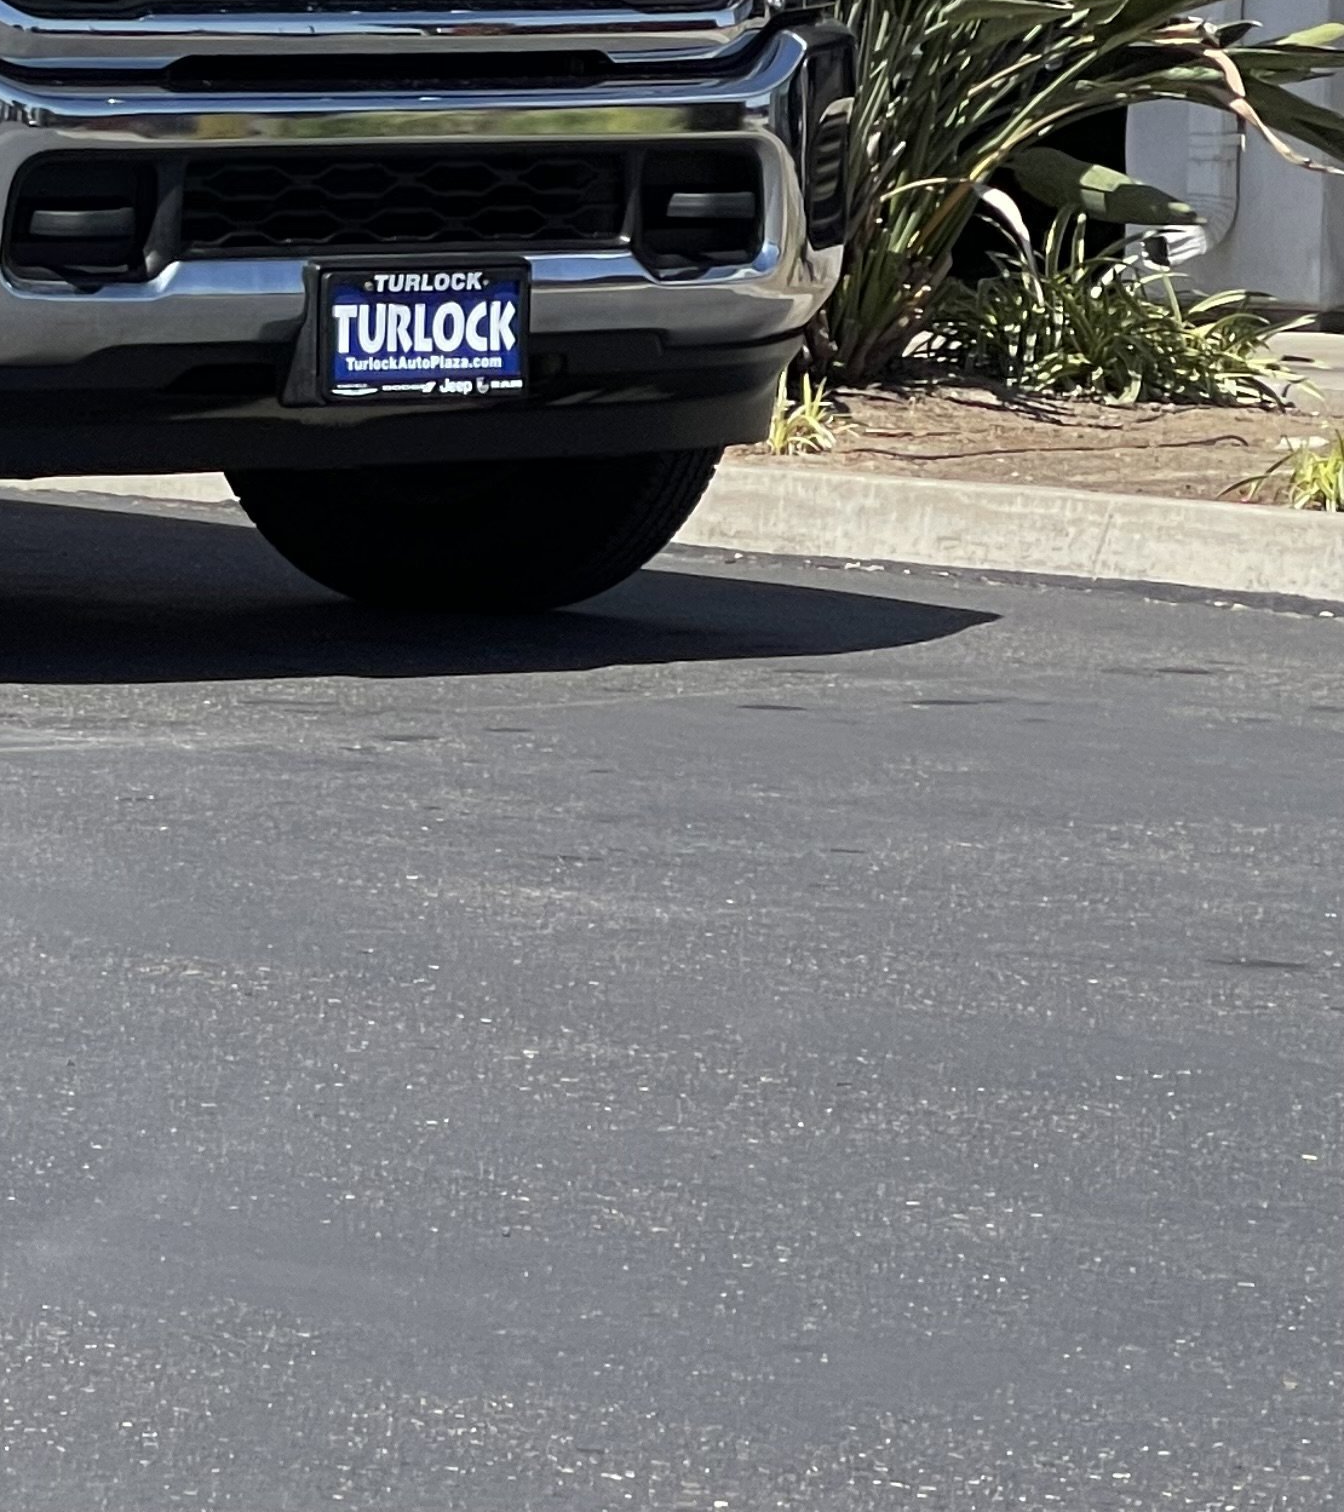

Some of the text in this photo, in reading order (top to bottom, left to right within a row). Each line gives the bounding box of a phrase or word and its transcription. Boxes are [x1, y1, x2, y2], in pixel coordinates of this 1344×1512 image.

[374, 272, 483, 292] TURLOCK
[332, 301, 516, 354] TURLOCK
[345, 355, 503, 371] TurlockAutoPlaza.com
[439, 377, 473, 395] Jeep
